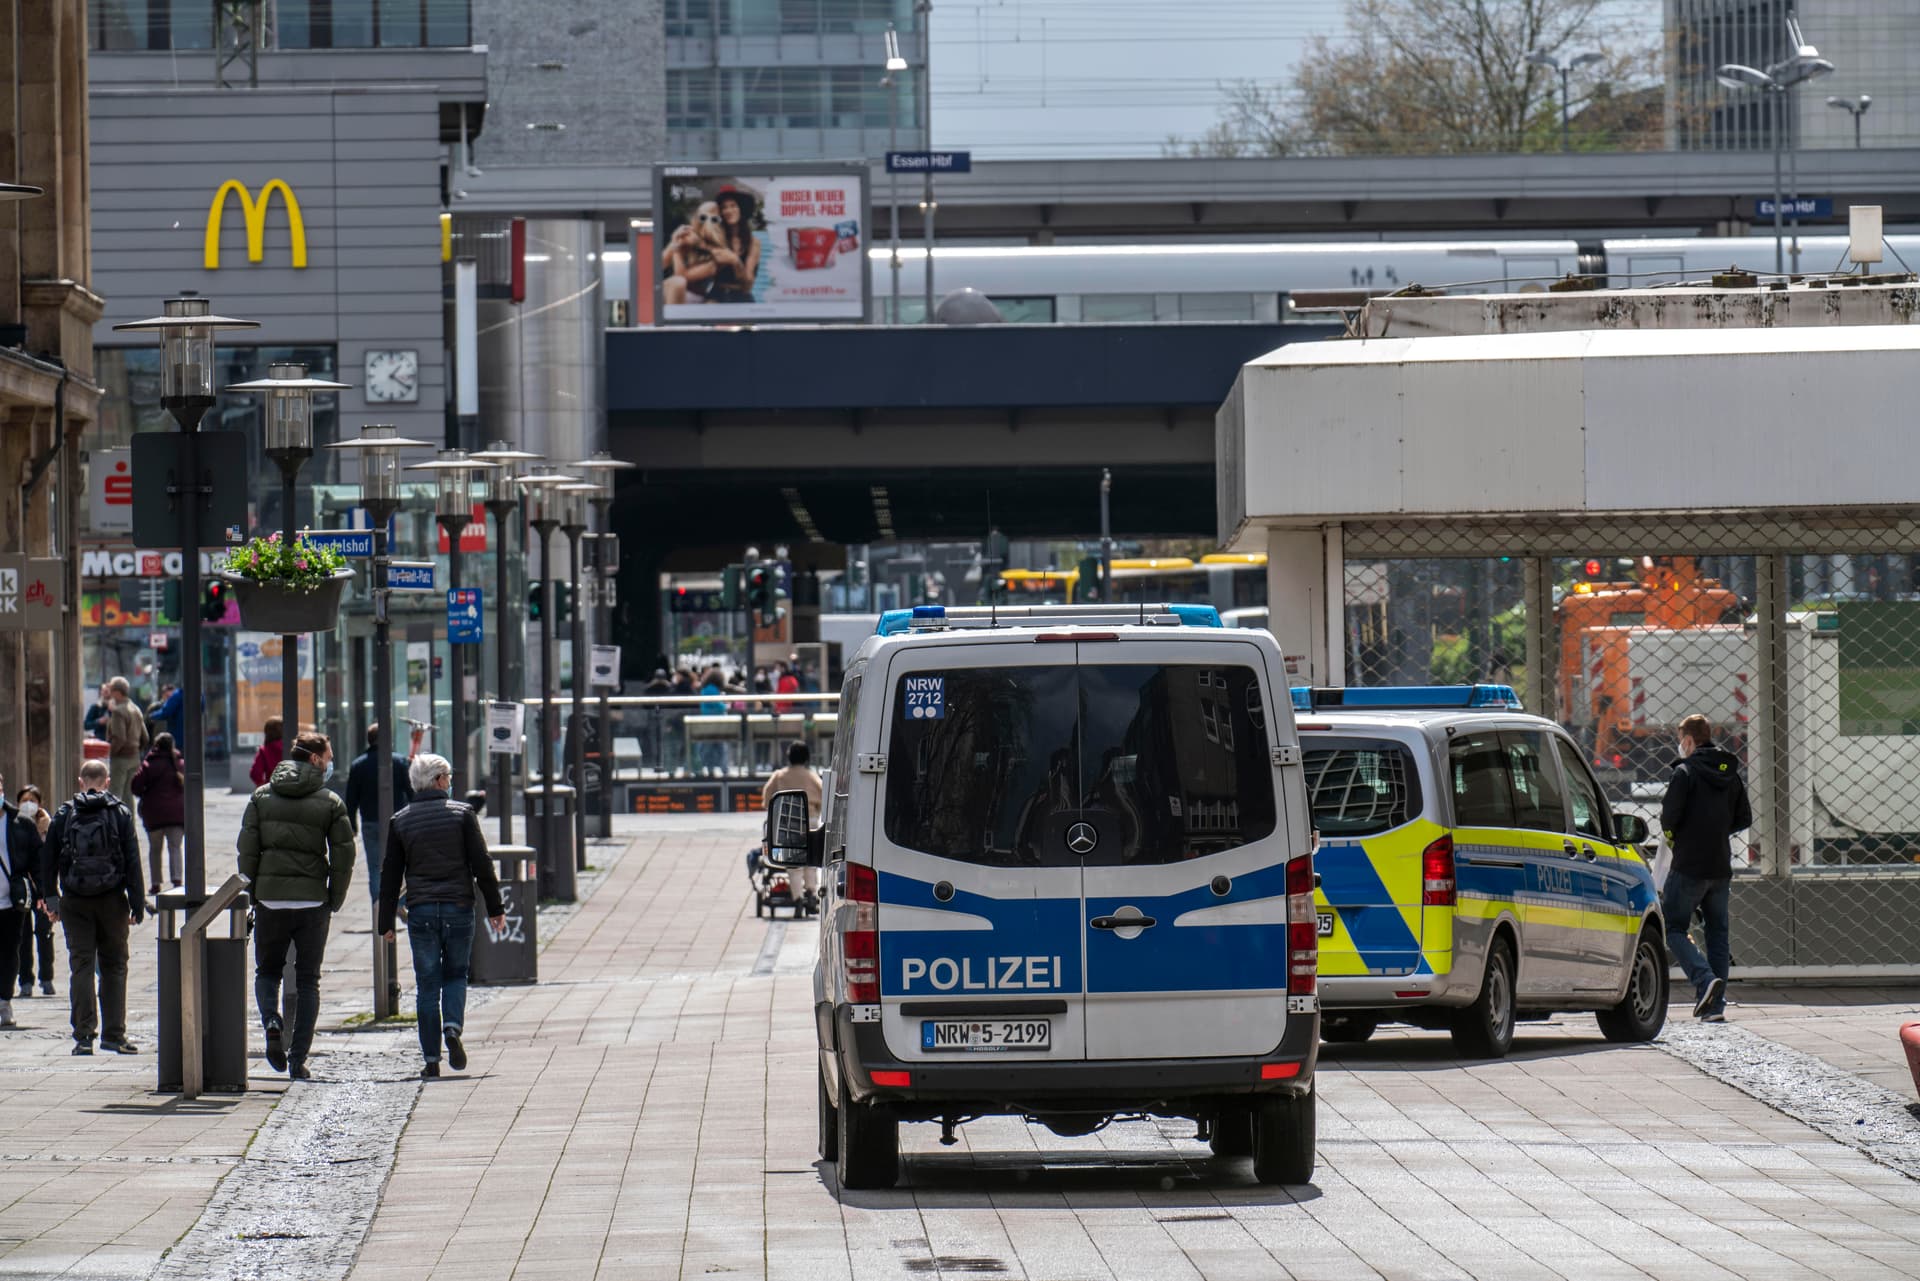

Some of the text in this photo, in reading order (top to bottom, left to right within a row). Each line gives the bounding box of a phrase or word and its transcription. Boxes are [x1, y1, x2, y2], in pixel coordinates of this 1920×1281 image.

[892, 154, 952, 168] Essen Hbf
[1760, 200, 1816, 214] Esen Hbf
[906, 678, 942, 691] NRW
[908, 692, 942, 705] 2712
[1536, 863, 1573, 894] POLIZEI
[902, 956, 1061, 990] POLIZEI
[935, 1024, 970, 1044] NRW
[982, 1023, 1048, 1044] 5-2199
